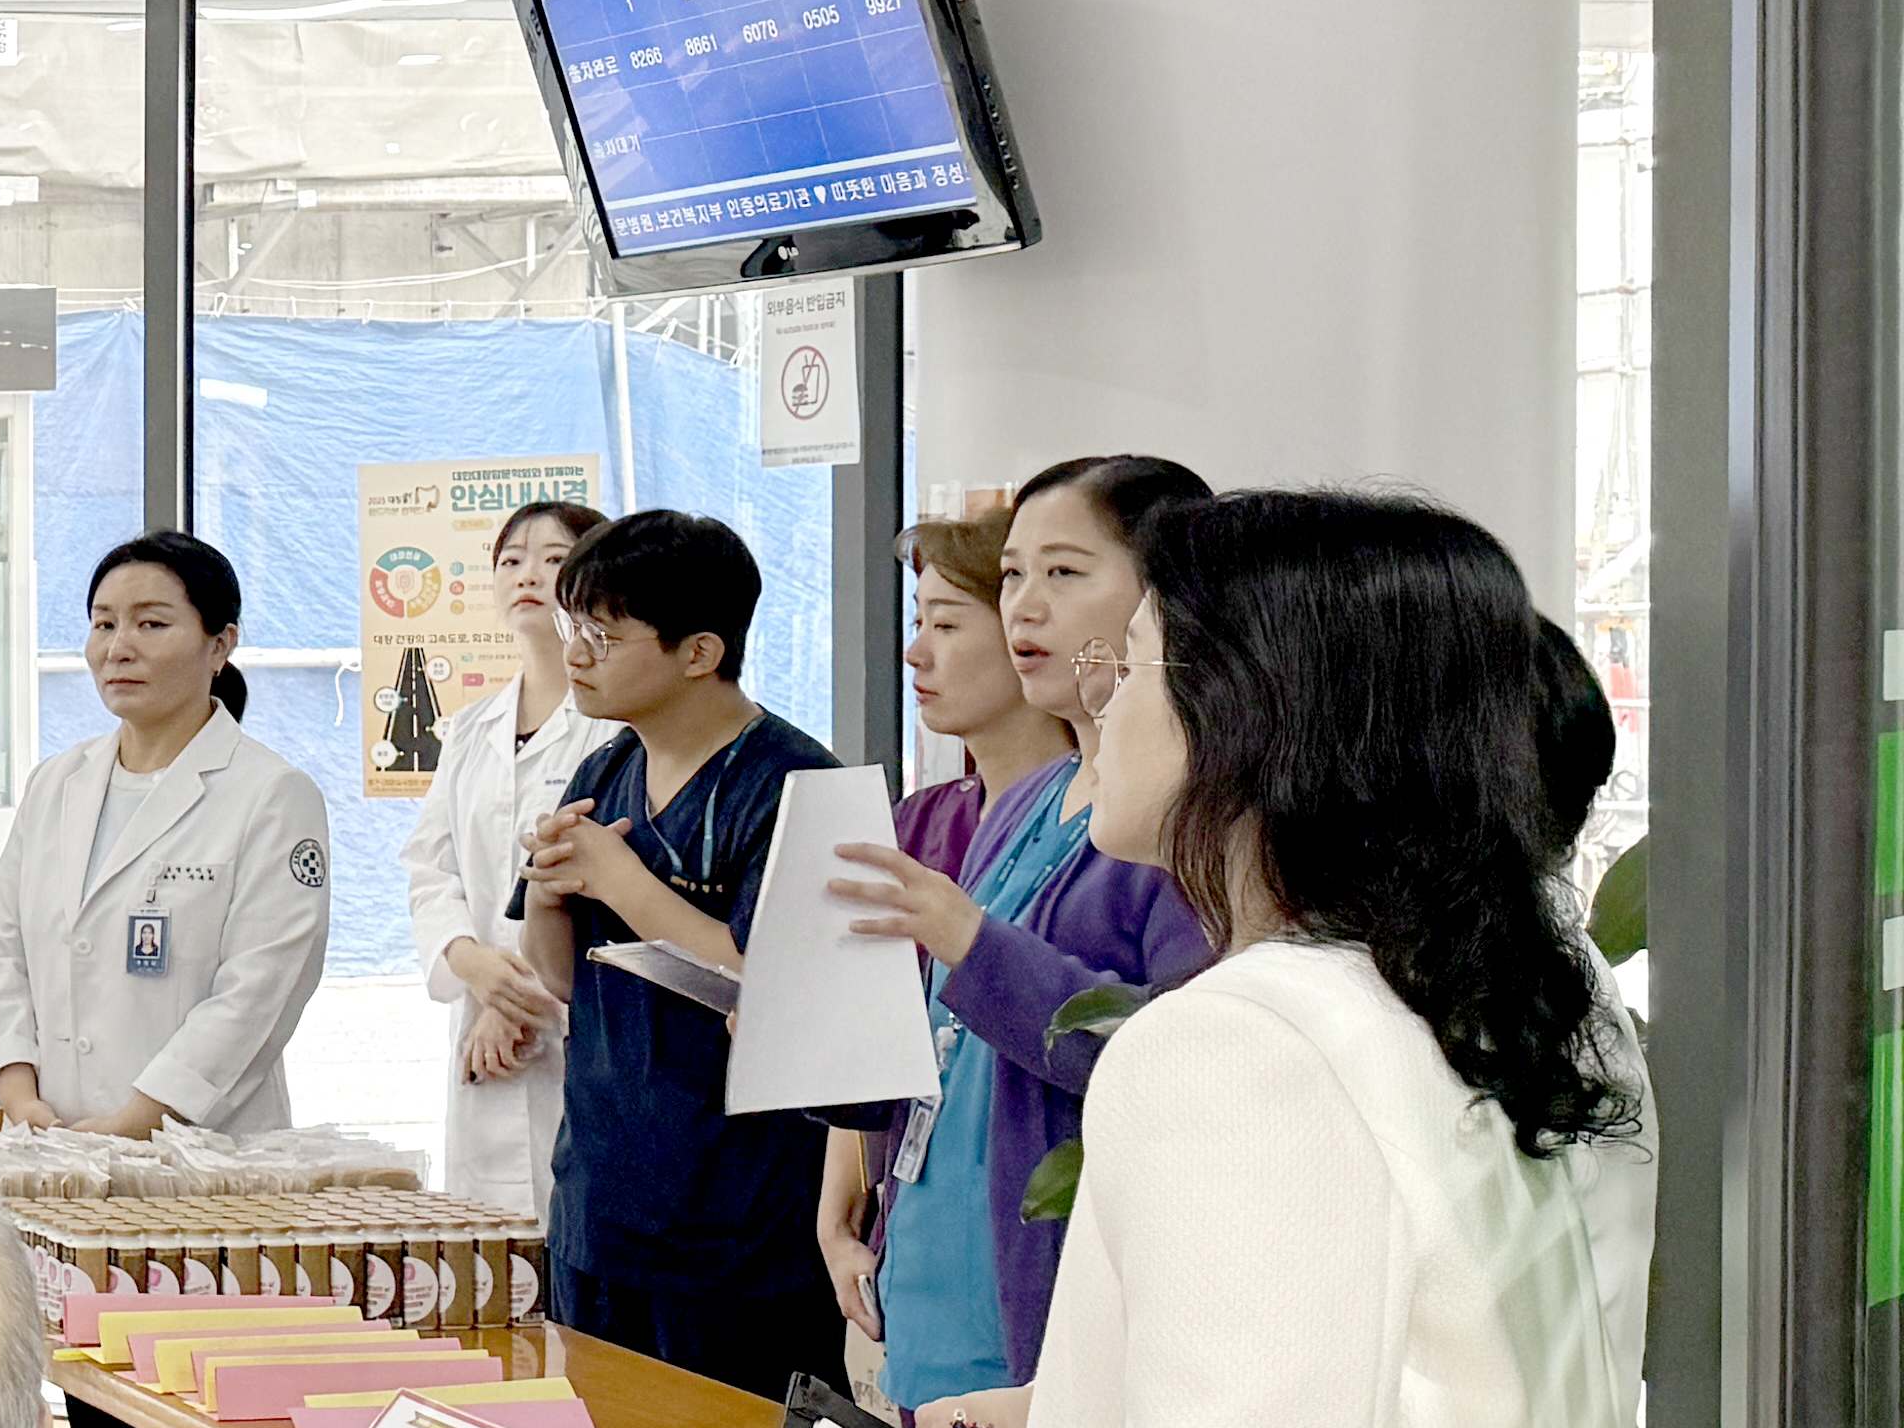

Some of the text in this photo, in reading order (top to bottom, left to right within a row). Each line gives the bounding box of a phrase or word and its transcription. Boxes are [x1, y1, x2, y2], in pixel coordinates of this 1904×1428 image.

[629, 45, 663, 69] 8266
[742, 19, 779, 45] 6078
[802, 4, 841, 31] 0505
[726, 168, 928, 220] 인증의료기관 따뜻한 마음과
[766, 290, 847, 317] 외부음식 반입금지
